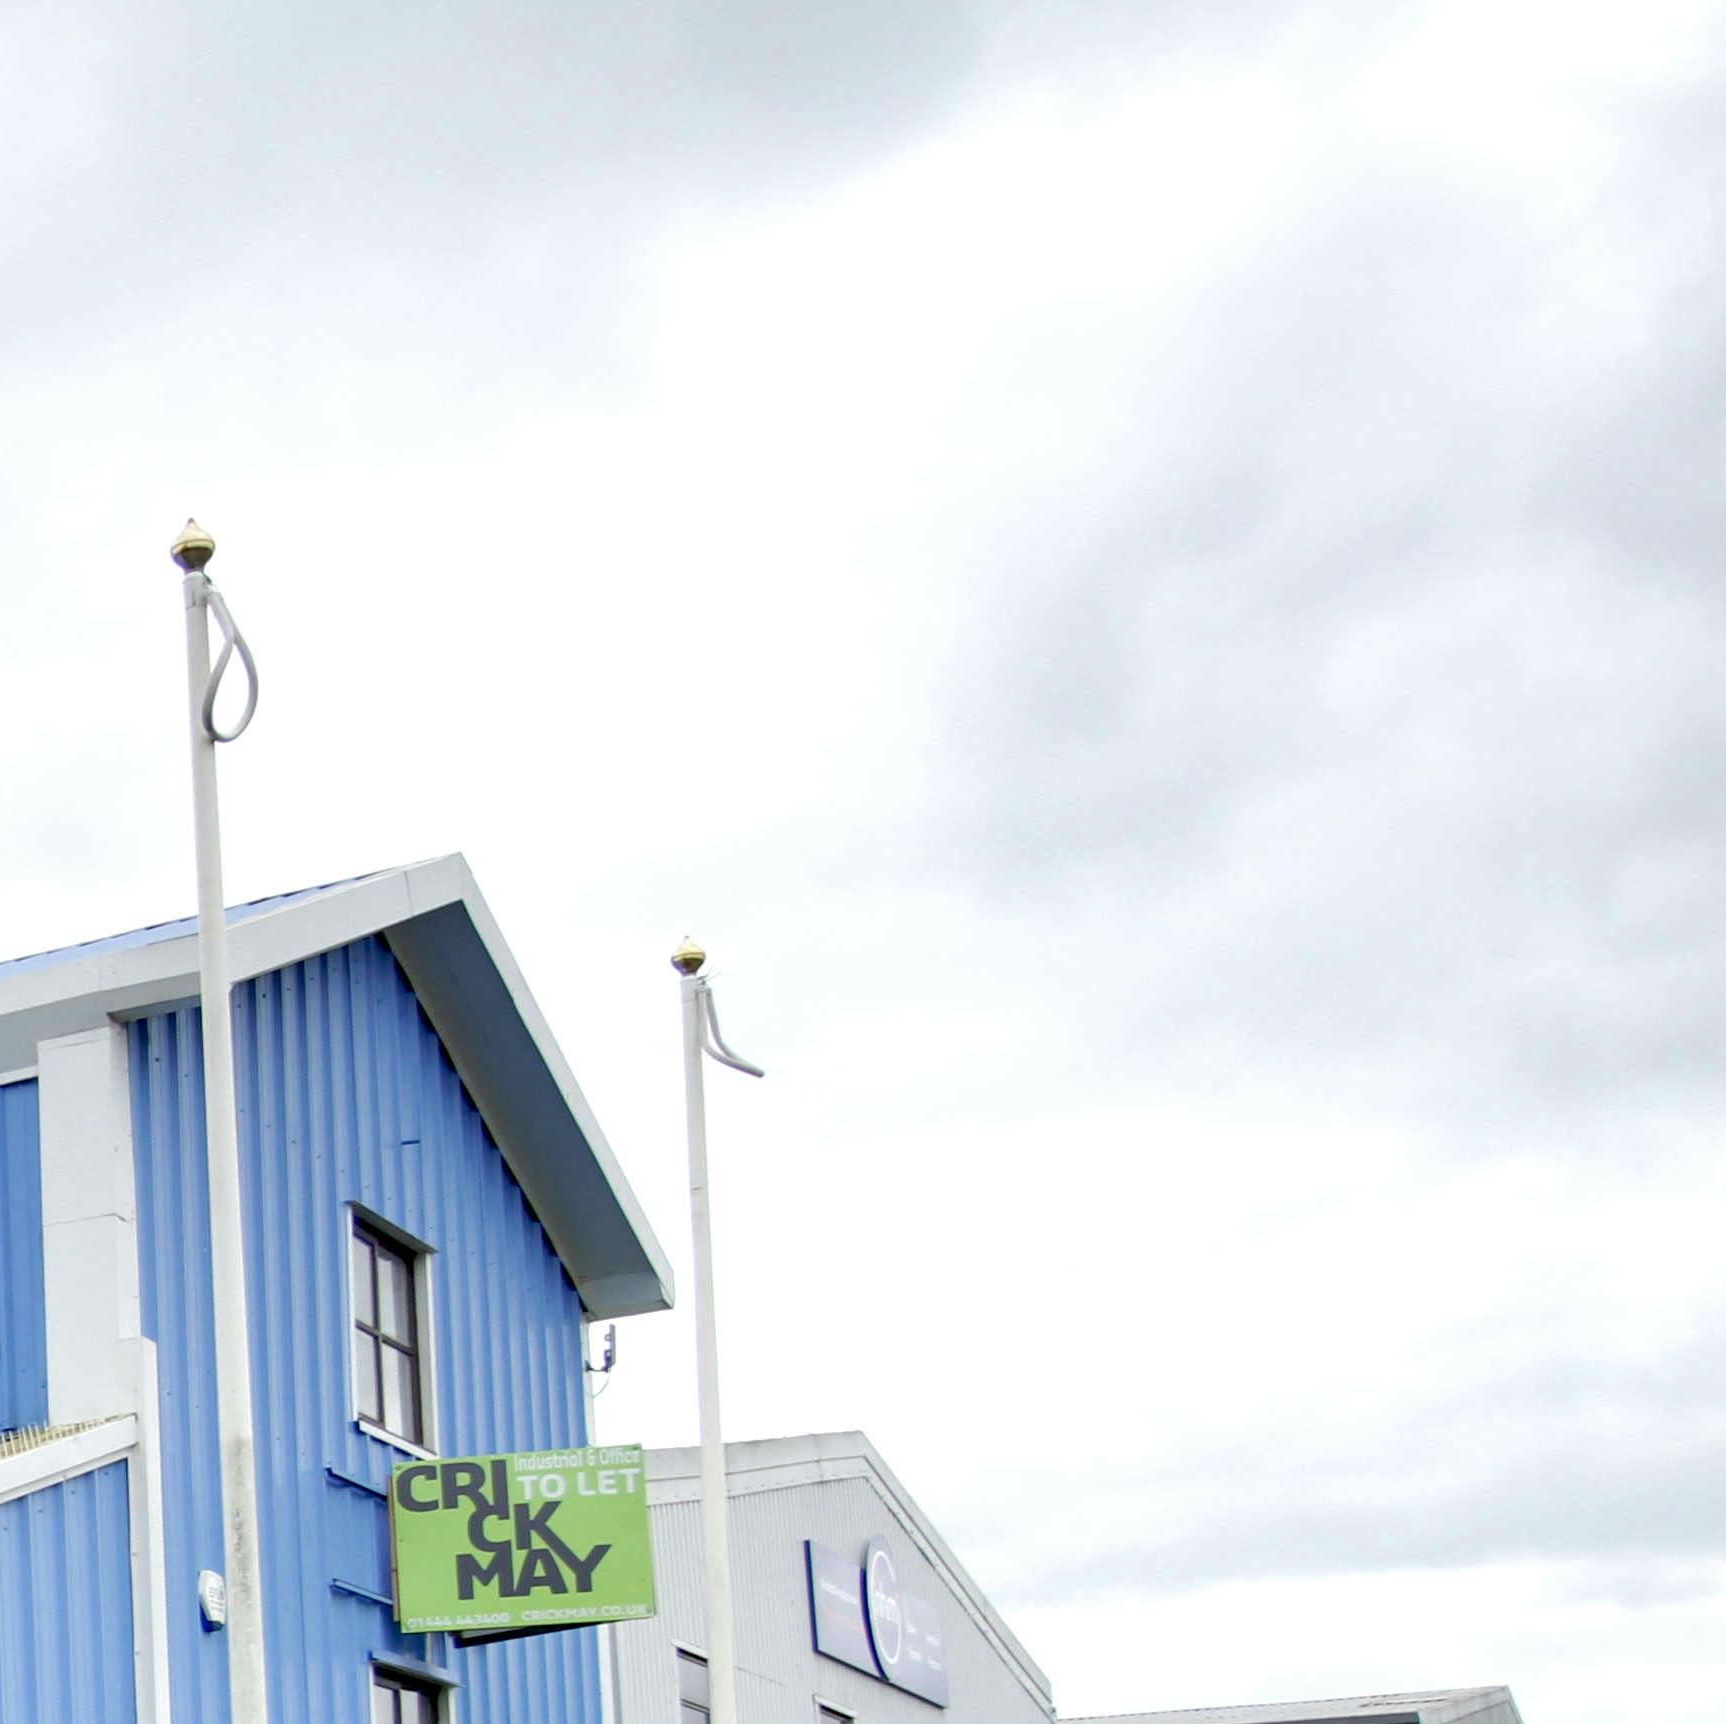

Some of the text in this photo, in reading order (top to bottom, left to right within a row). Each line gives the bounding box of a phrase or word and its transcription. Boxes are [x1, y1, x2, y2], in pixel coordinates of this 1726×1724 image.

[514, 1452, 583, 1471] Industrial
[599, 1448, 640, 1464] Office
[515, 1468, 640, 1500] TO LET
[397, 1459, 510, 1520] CRI
[467, 1500, 564, 1553] CK
[456, 1543, 613, 1600] MAY
